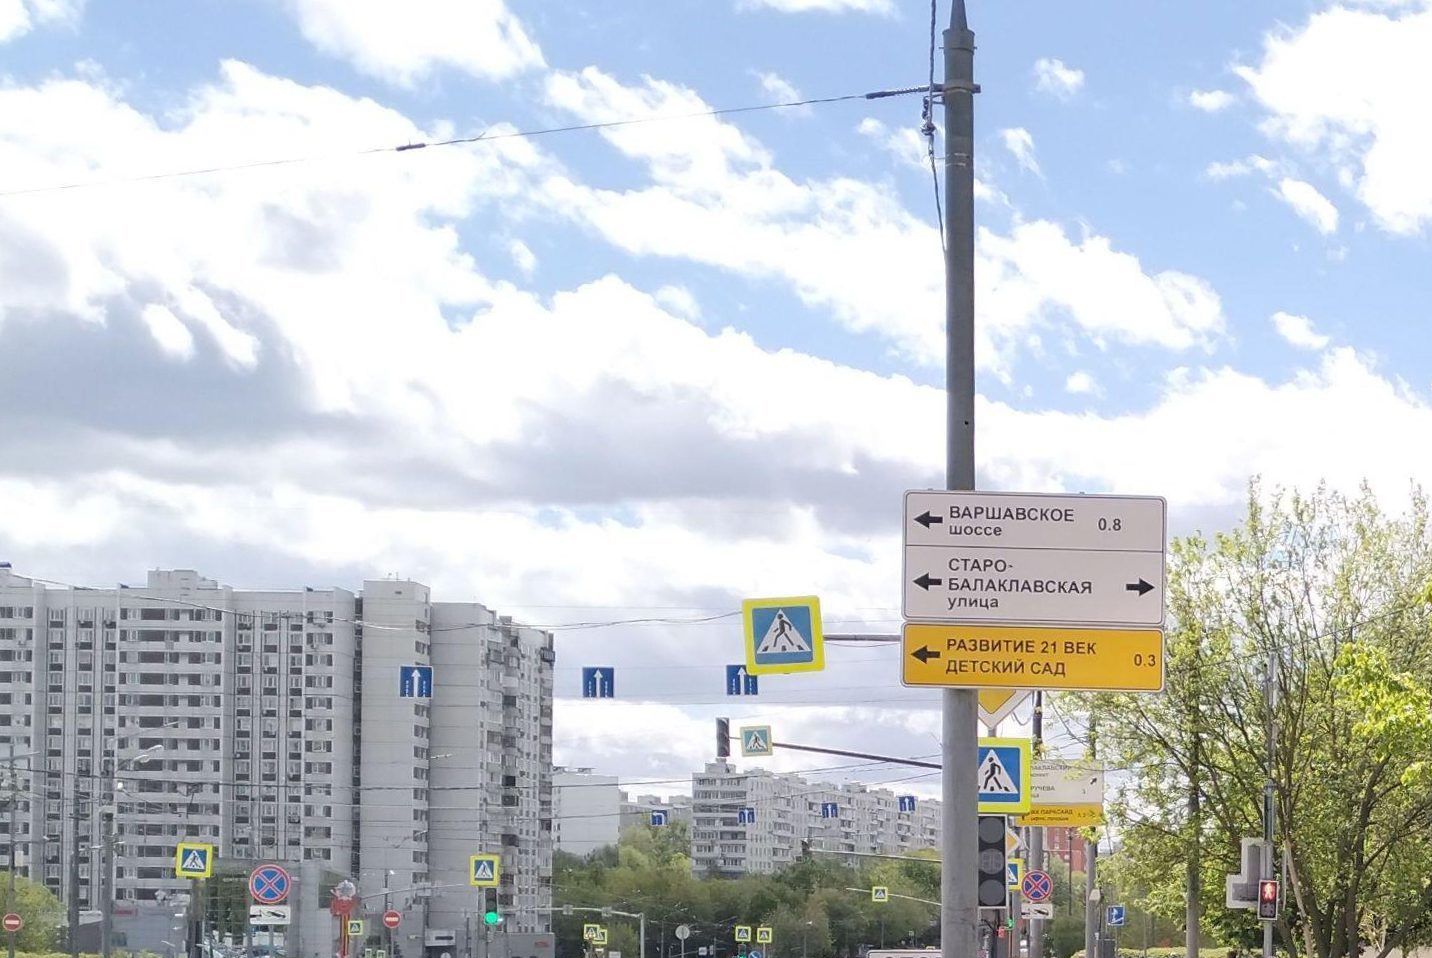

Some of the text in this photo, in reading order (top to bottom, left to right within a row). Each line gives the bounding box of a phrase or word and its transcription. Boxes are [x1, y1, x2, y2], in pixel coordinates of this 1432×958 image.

[949, 505, 1075, 523] ВАРШАВСКОЕ
[949, 524, 1002, 537] шоссе
[1098, 518, 1122, 531] 0.8
[948, 557, 1013, 573] СТАРО-
[948, 578, 1092, 595] БАЛАКЛАВСКАЯ
[948, 596, 999, 610] улица
[946, 638, 1096, 655] РАЗВИТИЕ 21 ВЕК
[946, 657, 1066, 677] ДЕТСКИЙ САД
[1134, 654, 1156, 667] 0.3
